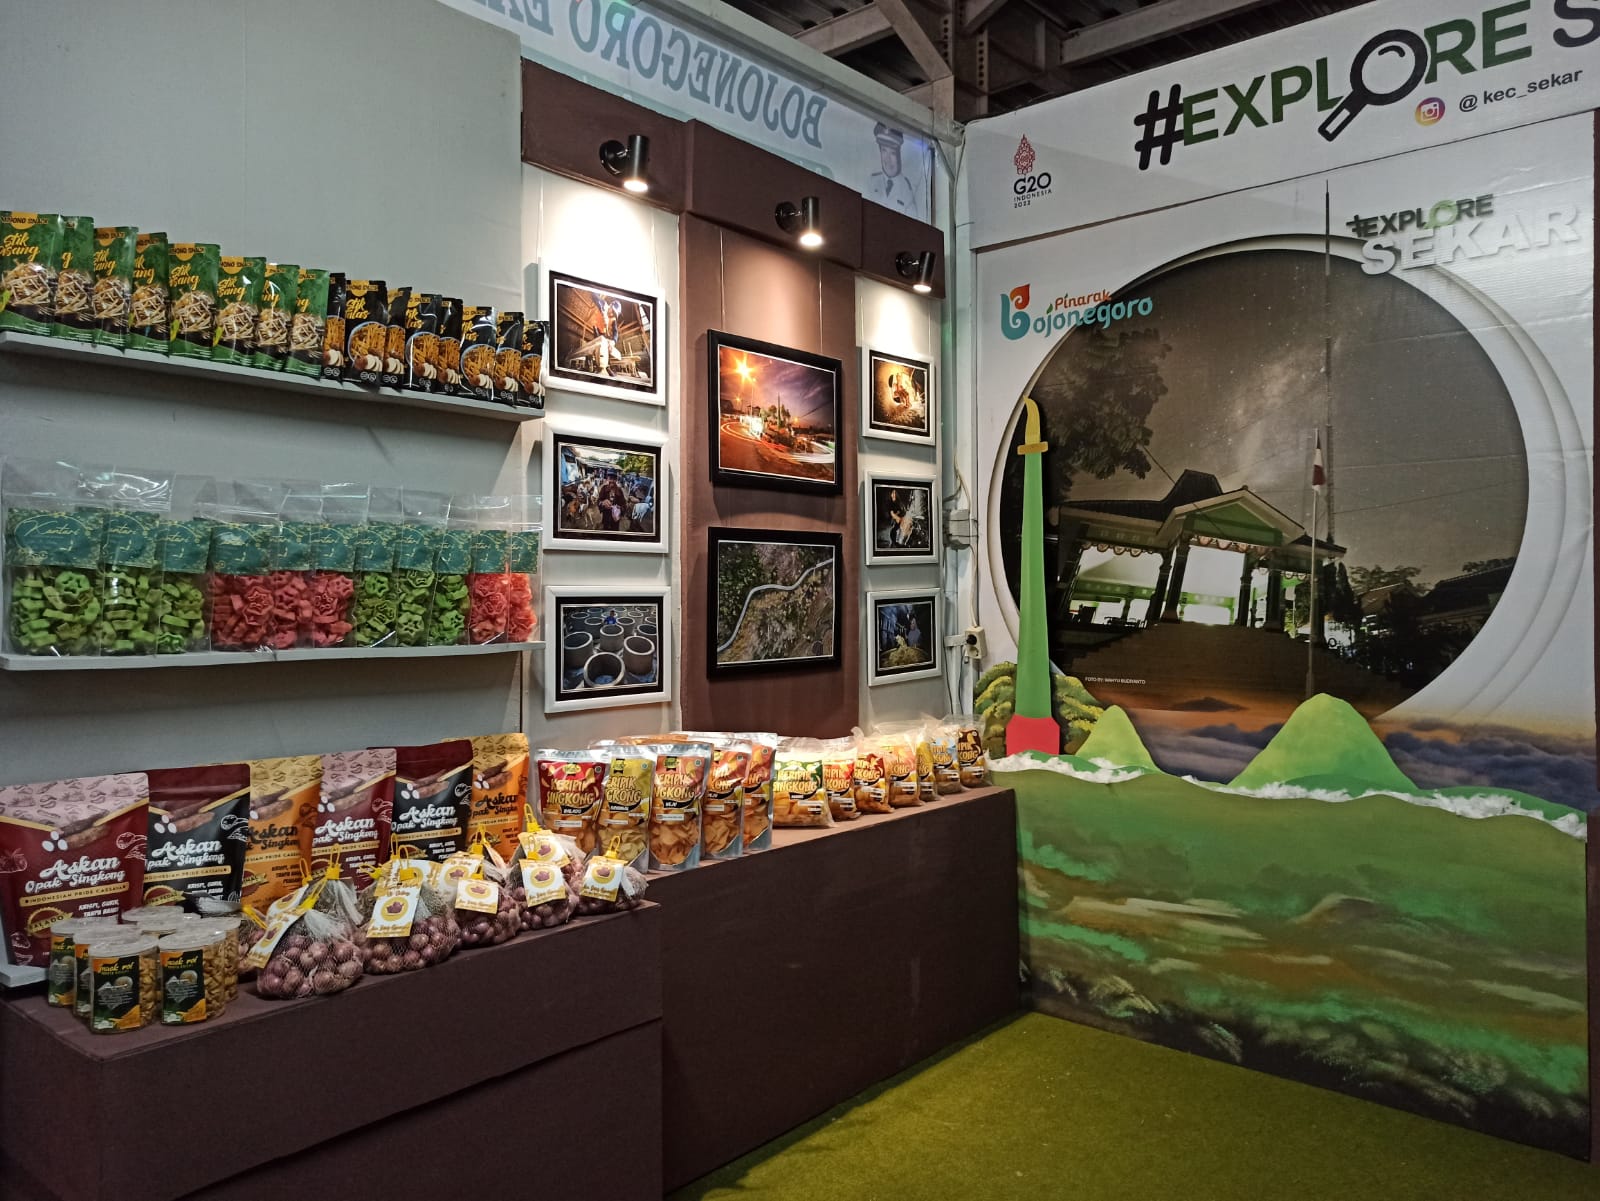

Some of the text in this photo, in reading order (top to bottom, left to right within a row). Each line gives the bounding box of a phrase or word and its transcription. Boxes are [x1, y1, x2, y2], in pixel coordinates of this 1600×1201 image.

[1483, 70, 1583, 105] kec_sekar
[1013, 189, 1053, 203] INDONESIA
[1346, 193, 1494, 238] #EXPLORE
[1360, 203, 1582, 276] SEKAR
[1054, 289, 1113, 311] Pinarak
[608, 775, 638, 791] ERIPIK
[420, 816, 459, 829] Singkong
[312, 829, 379, 847] pak Singkong
[144, 853, 226, 871] pak Singkong
[24, 870, 127, 894] Opak Singkong
[30, 893, 73, 904] INDONESIAN
[74, 889, 94, 897] PRIDE
